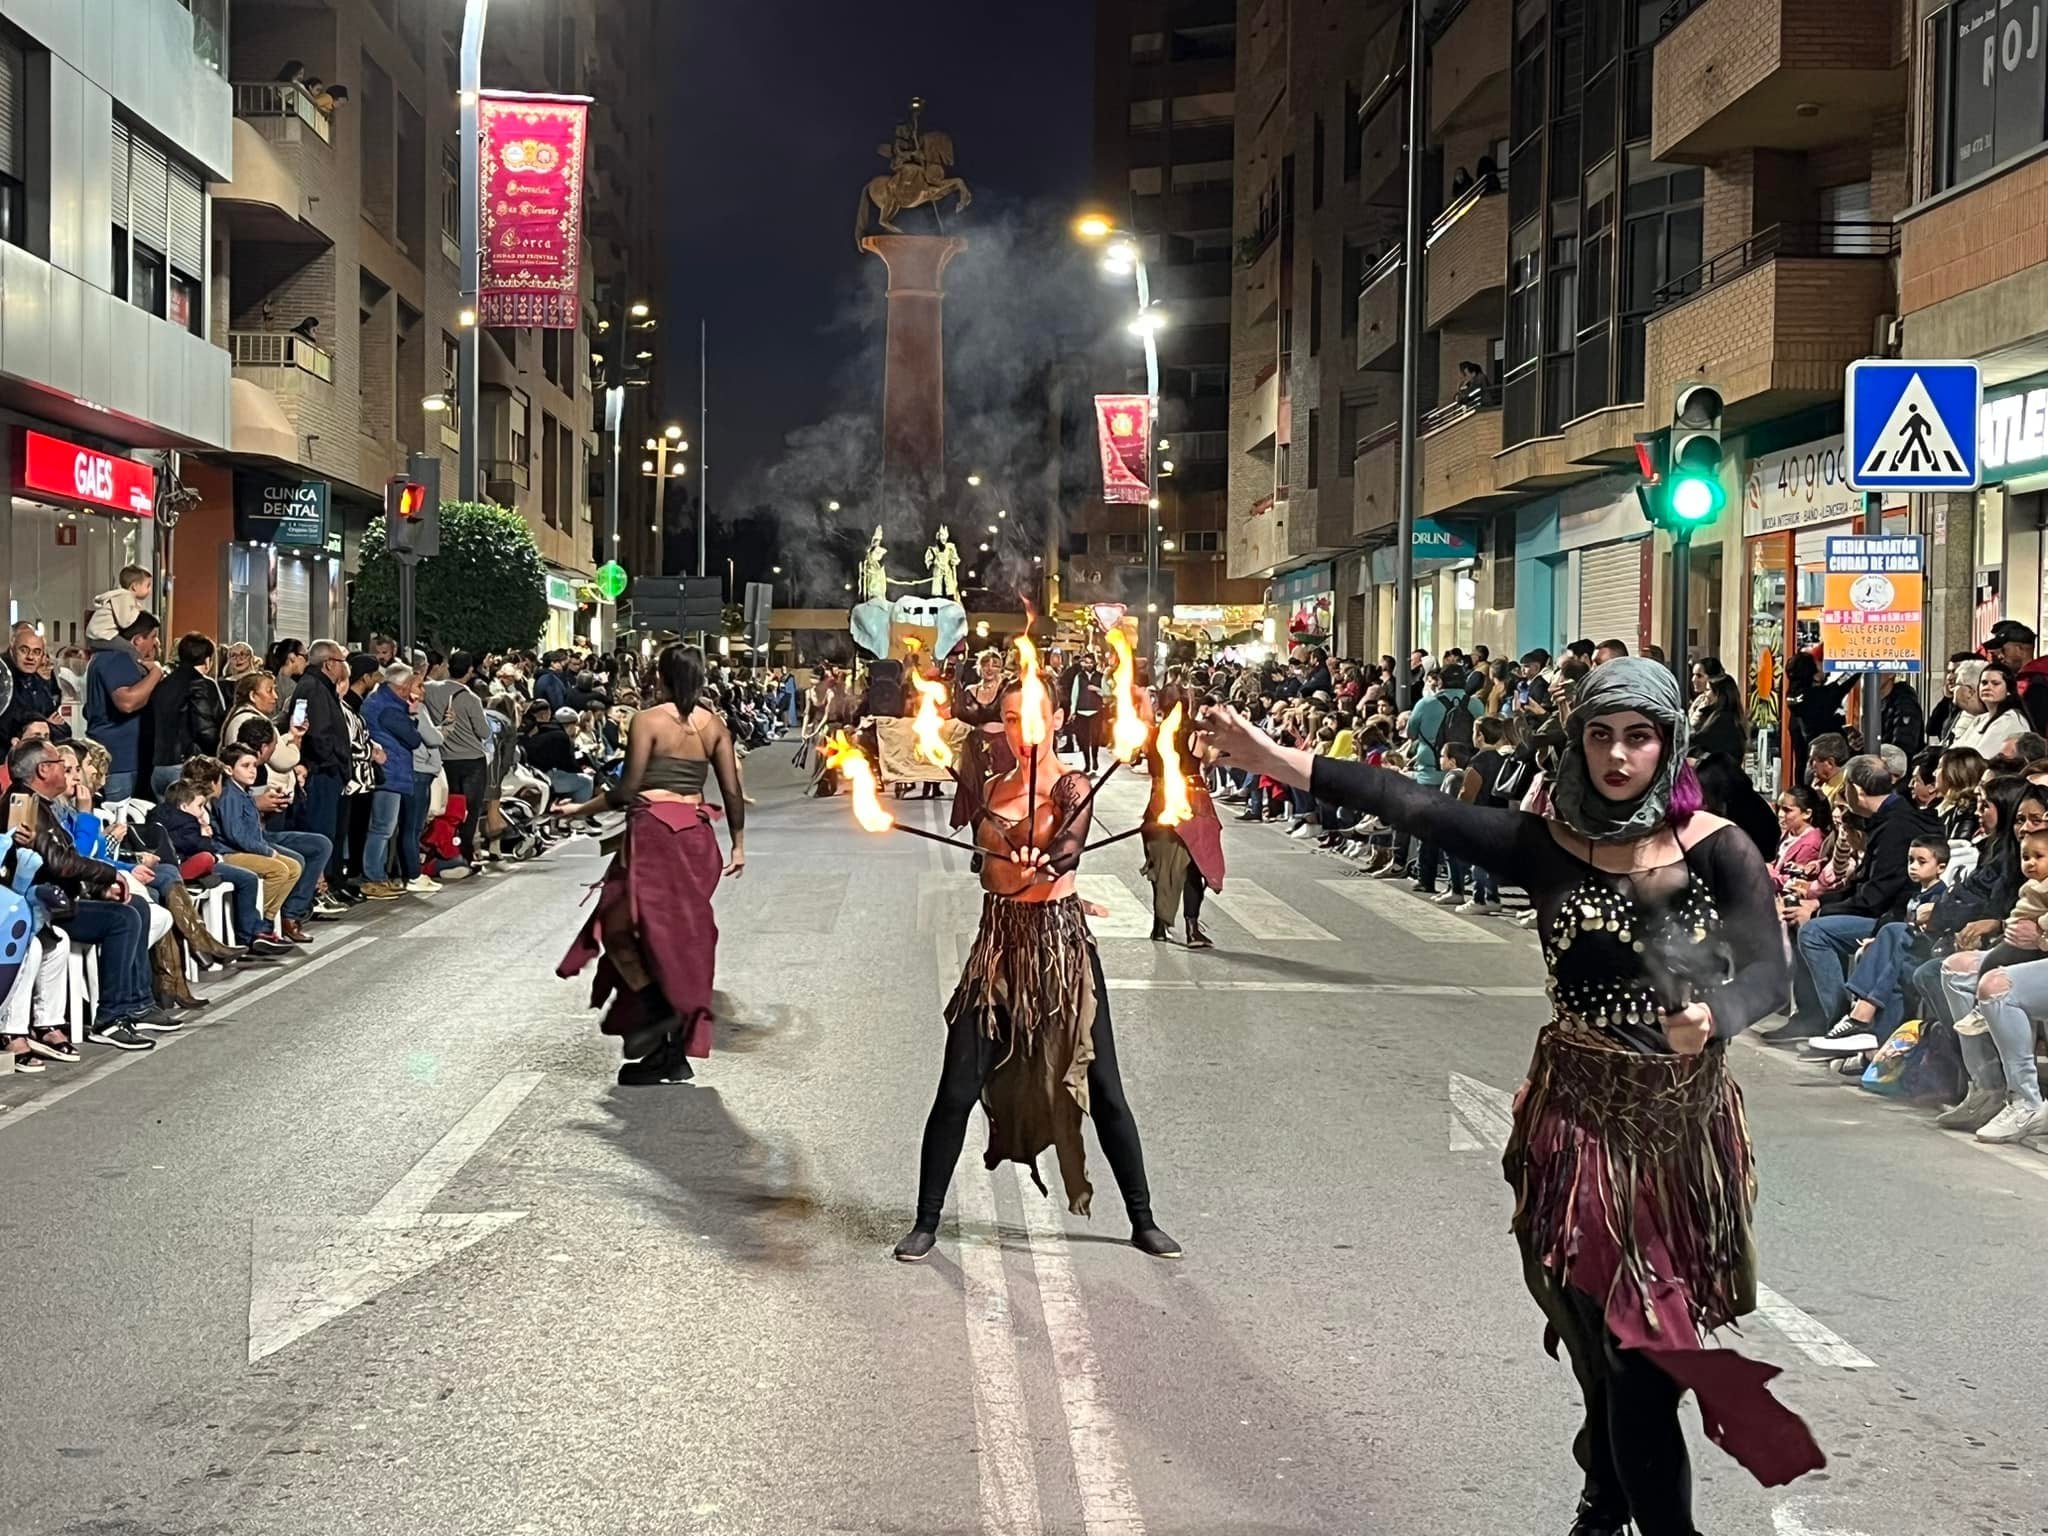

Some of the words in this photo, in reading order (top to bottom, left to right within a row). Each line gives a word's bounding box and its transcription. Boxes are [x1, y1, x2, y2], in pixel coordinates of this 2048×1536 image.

[74, 450, 113, 501] GAES
[1778, 456, 1799, 498] 40
[263, 502, 319, 517] DENTAL
[1412, 532, 1450, 545] DRUNI
[1832, 540, 1865, 554] MEDIA
[1829, 556, 1869, 571] CIUDAD
[1870, 556, 1884, 571] DE
[1885, 555, 1919, 571] LORCA
[1840, 624, 1865, 634] CALLE
[1867, 624, 1905, 634] CERRADA
[1857, 648, 1868, 658] DE
[1871, 648, 1880, 658] LA
[1883, 648, 1916, 658] PRUEBA
